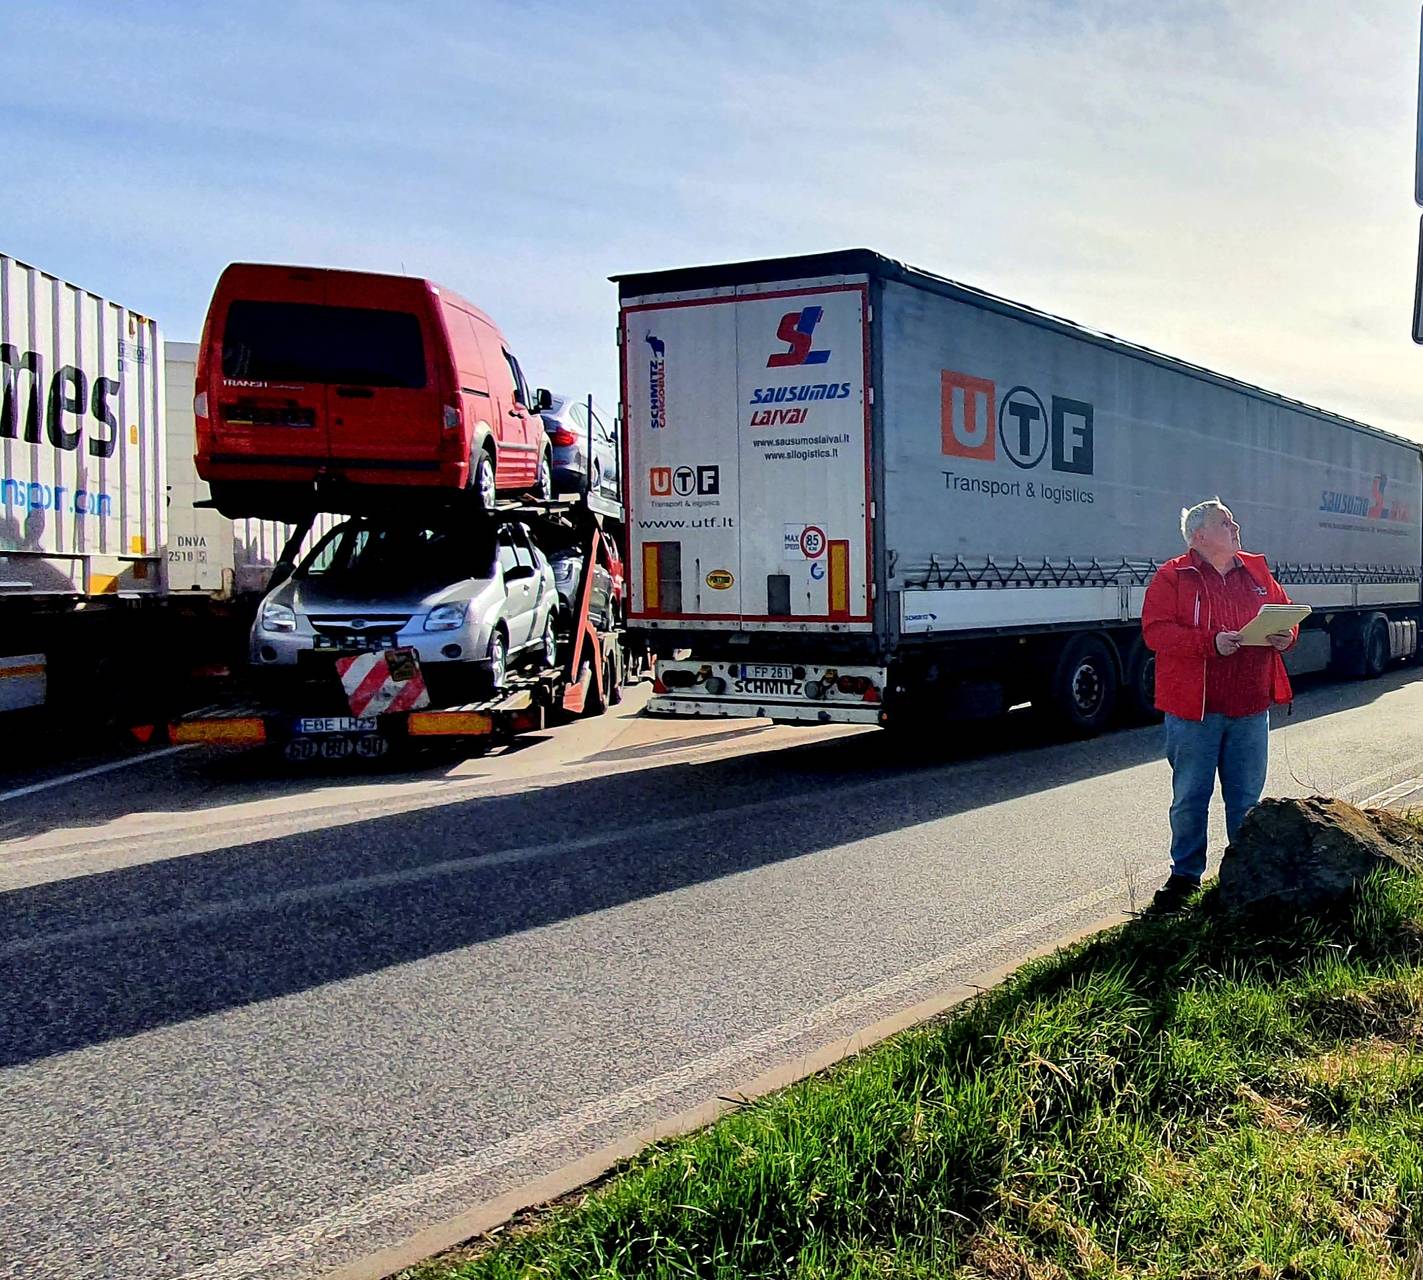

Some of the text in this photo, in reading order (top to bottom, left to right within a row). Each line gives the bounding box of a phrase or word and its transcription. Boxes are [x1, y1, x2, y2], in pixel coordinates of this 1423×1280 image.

[650, 360, 659, 429] SCHMITZ
[658, 360, 666, 428] CARGOBULL
[945, 376, 1091, 470] UTF
[650, 466, 719, 496] UTF
[941, 470, 1094, 504] Transport & logistics
[639, 517, 734, 528] www.utf.lt
[177, 535, 207, 547] DNVA
[784, 534, 800, 543] MAX
[806, 534, 819, 546] 85
[771, 667, 790, 680] 261
[735, 680, 802, 696] SCHMITZ
[303, 719, 334, 731] EBE
